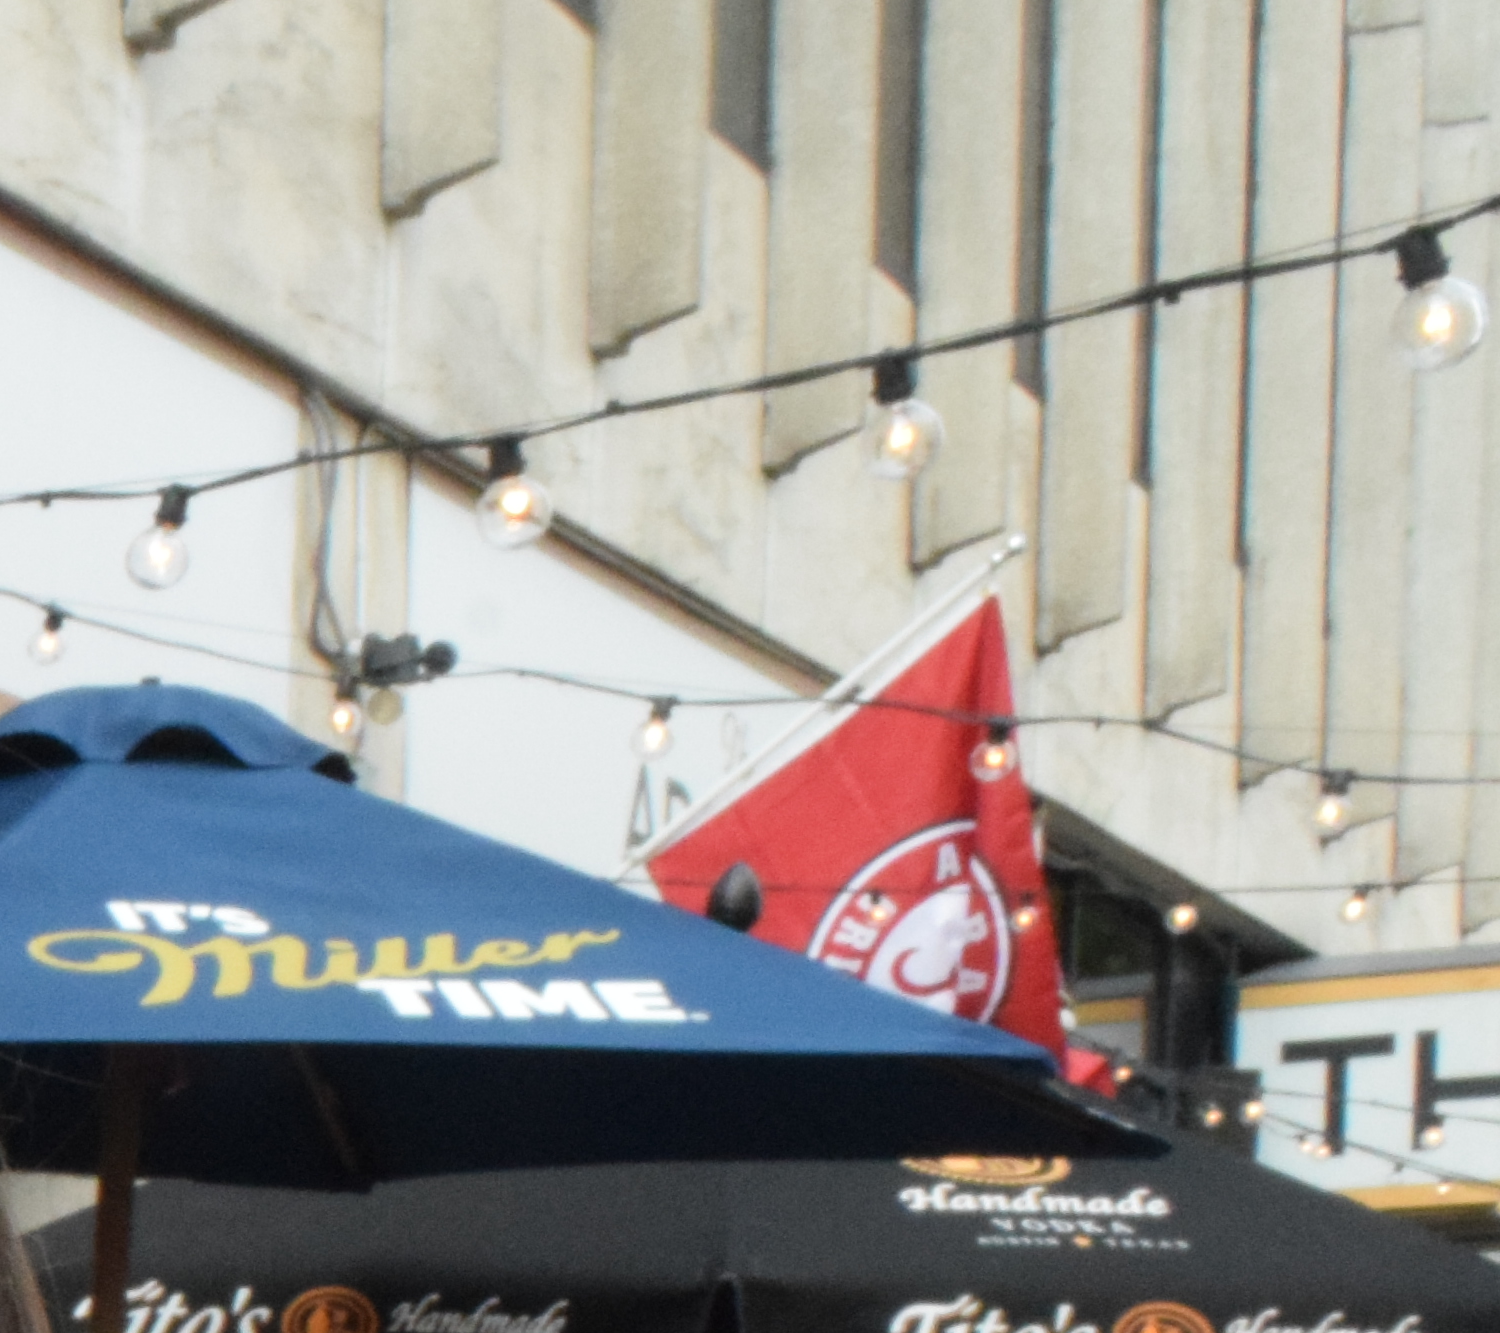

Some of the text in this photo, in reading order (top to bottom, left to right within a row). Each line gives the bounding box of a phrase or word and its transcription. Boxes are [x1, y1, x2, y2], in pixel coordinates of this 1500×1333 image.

[104, 900, 270, 937] IT'S
[28, 928, 621, 1007] Miller
[899, 1182, 1173, 1217] Handmade
[990, 1216, 1135, 1236] VODKA
